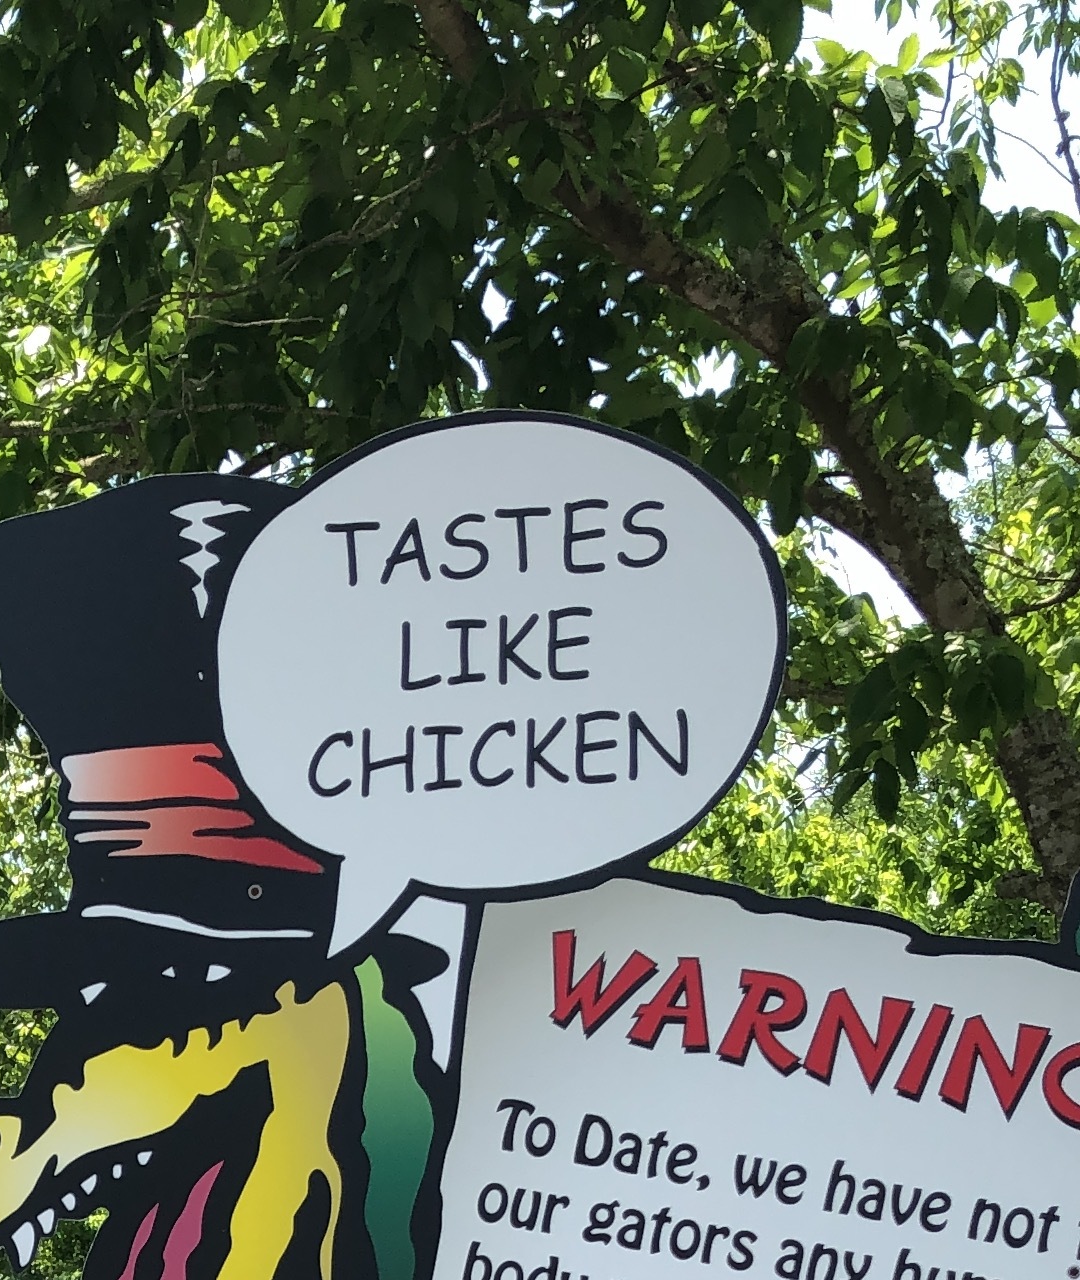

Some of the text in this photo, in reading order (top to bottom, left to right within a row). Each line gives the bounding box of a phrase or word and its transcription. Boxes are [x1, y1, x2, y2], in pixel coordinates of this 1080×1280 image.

[325, 499, 667, 586] TASTES
[401, 607, 592, 690] LIKE
[308, 709, 688, 797] CHICKEN
[497, 1099, 556, 1157] To
[574, 1114, 709, 1190] Date,
[735, 1155, 807, 1204] we
[824, 1160, 951, 1232] have
[968, 1199, 1060, 1252] not
[478, 1183, 569, 1233] our
[583, 1201, 757, 1270] gators
